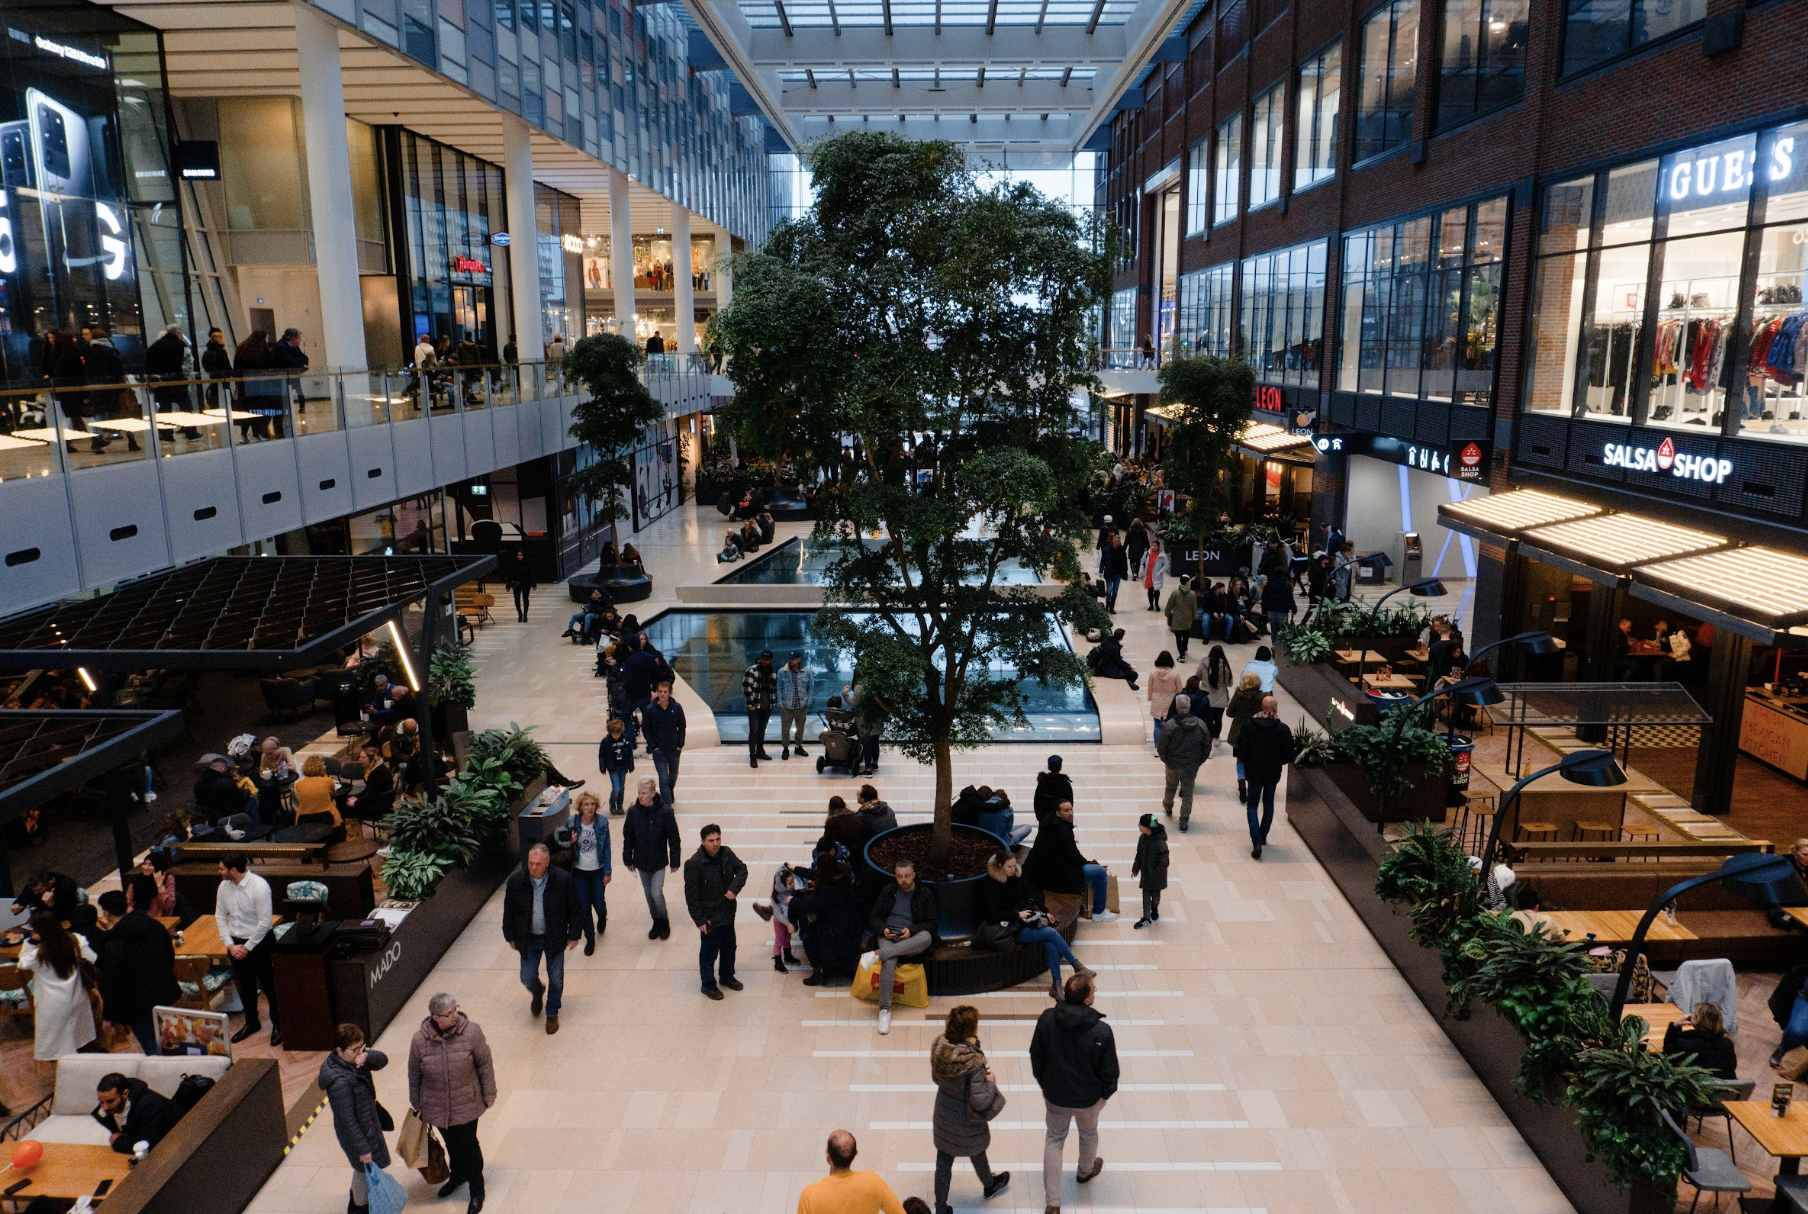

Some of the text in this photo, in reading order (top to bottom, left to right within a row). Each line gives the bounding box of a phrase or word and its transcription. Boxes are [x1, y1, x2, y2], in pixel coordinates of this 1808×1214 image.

[36, 35, 65, 58] Galaxy
[183, 169, 215, 177] SAMSUNG
[1255, 386, 1282, 412] LEON
[1603, 443, 1733, 484] SALSA SHOP
[1185, 550, 1220, 561] LEON
[1744, 719, 1790, 749] MEXICAN
[1742, 736, 1786, 766] KITCHEN
[370, 941, 401, 989] MADO
